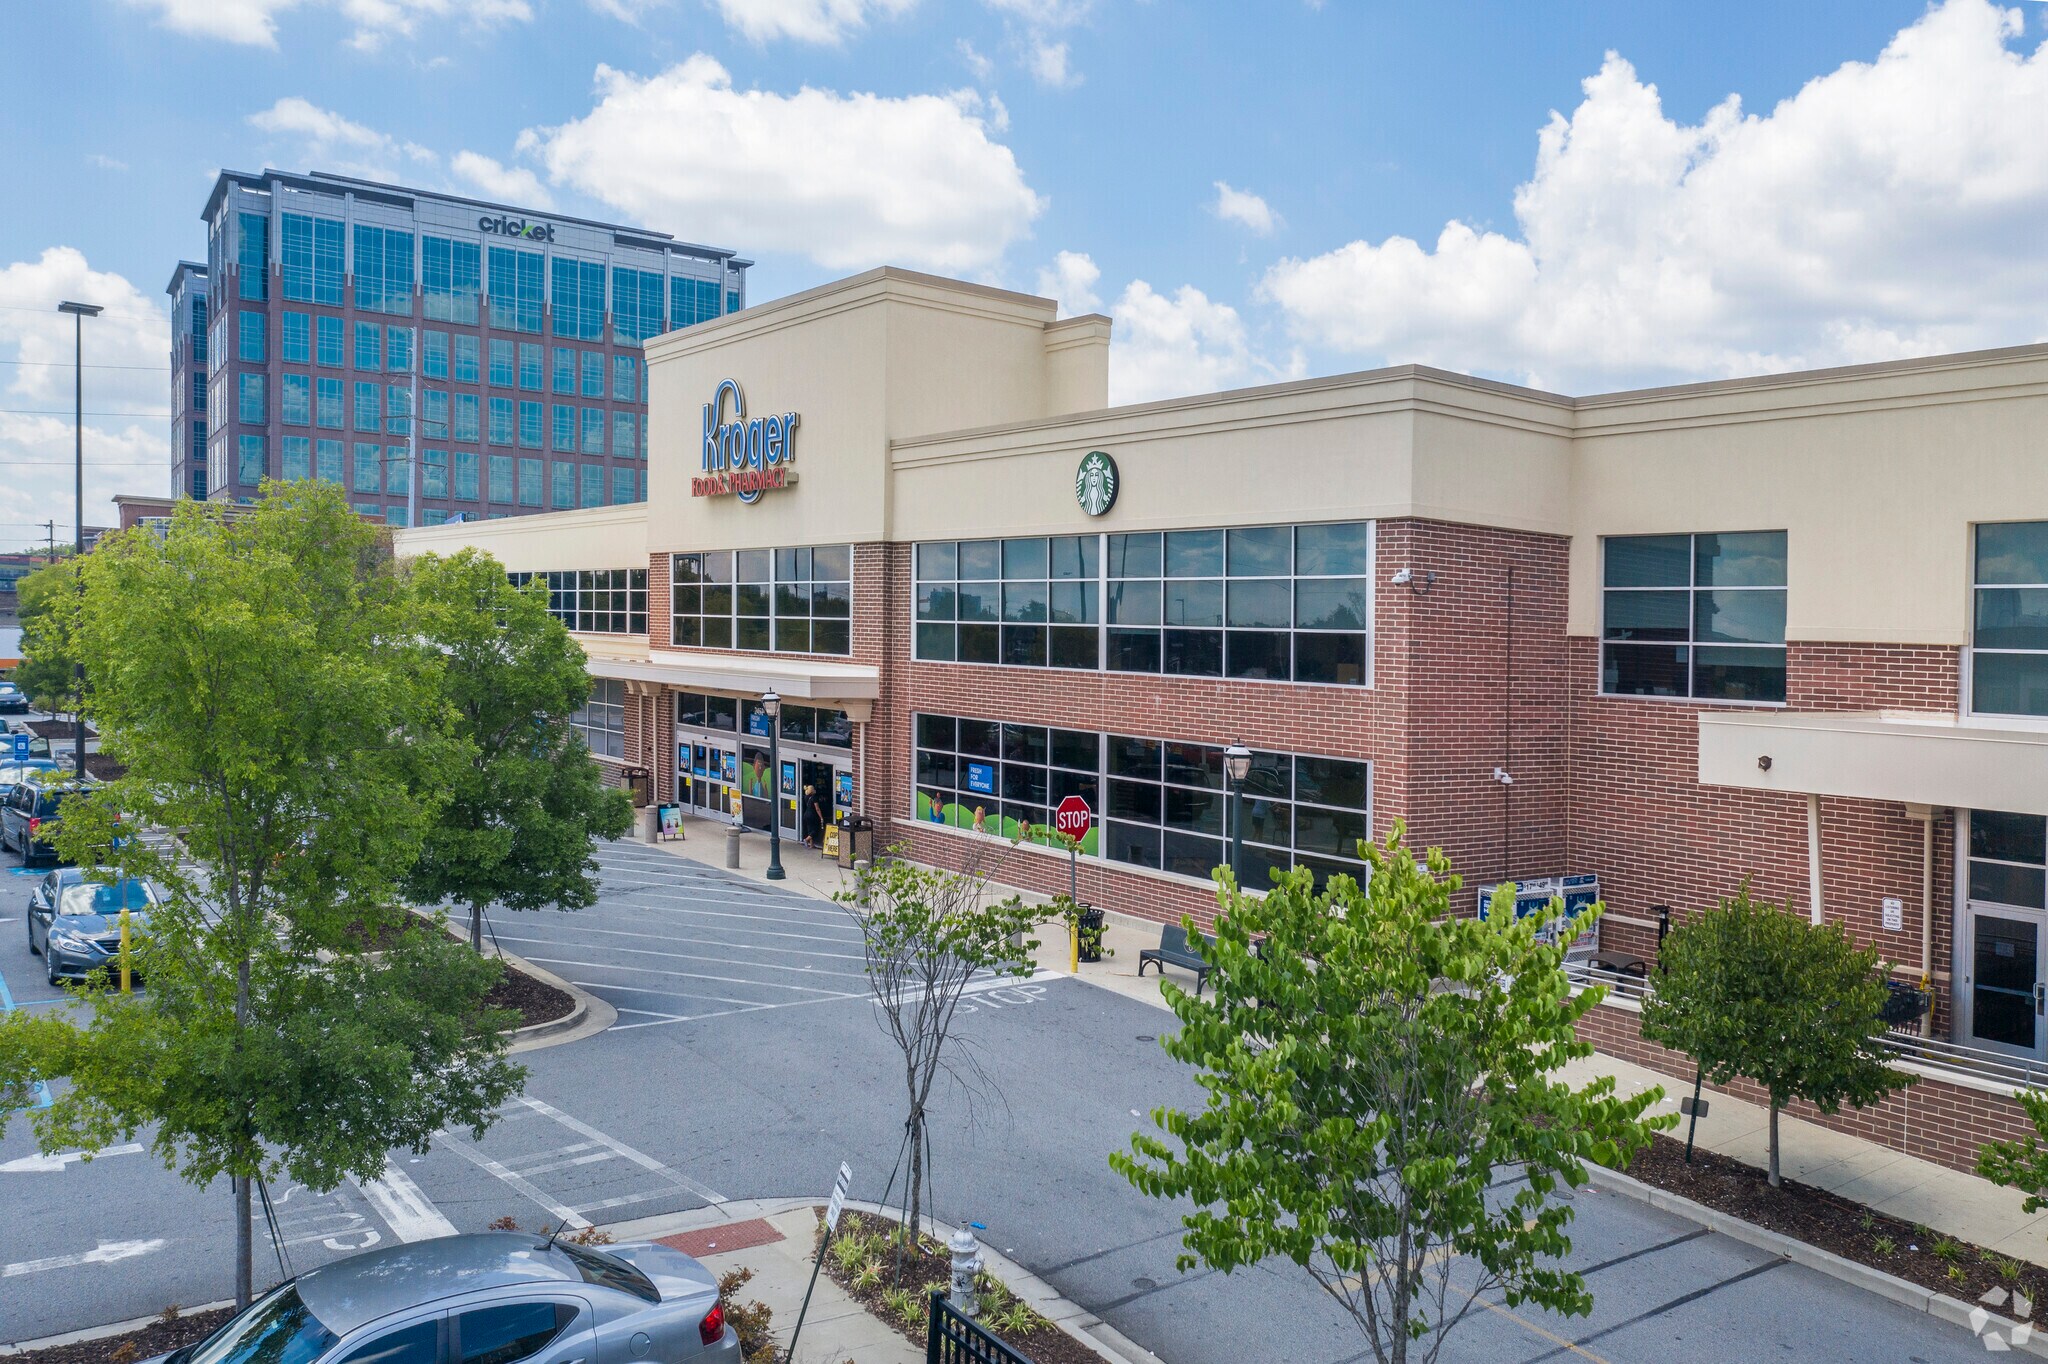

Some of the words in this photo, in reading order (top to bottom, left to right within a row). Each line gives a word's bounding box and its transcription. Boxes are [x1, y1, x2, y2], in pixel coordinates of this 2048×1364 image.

[479, 216, 555, 242] cricket
[701, 378, 800, 504] Kroger
[691, 477, 717, 497] FOOD
[718, 472, 727, 494] &
[728, 468, 786, 492] PHARMACY
[970, 773, 978, 781] FOR
[1059, 810, 1088, 829] STOP
